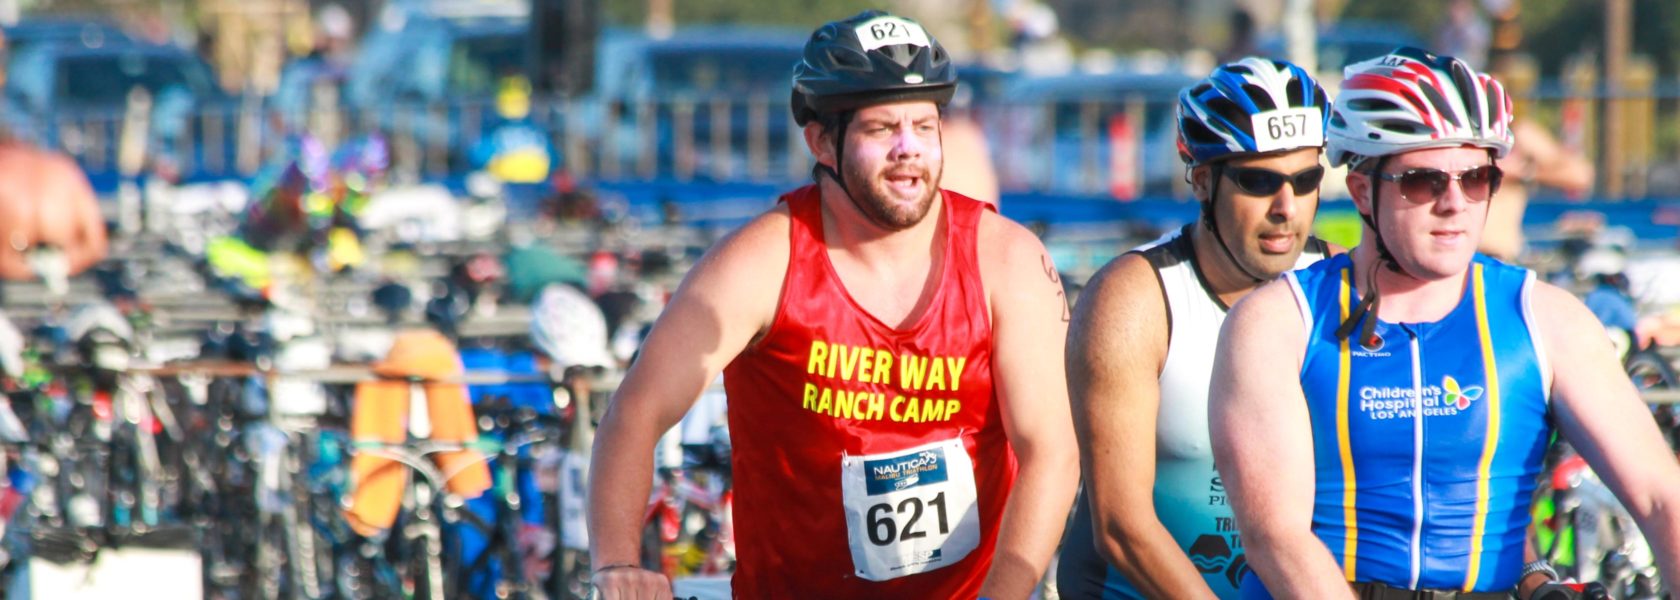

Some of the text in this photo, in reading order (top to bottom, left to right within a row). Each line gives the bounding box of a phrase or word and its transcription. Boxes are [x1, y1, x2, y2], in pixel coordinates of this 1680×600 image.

[870, 21, 911, 41] 621
[1267, 114, 1307, 140] 657
[807, 341, 967, 391] RIVER WAY
[1360, 385, 1441, 400] Children's
[802, 382, 962, 424] RANCH CAMP
[1361, 397, 1439, 414] Hospital
[1370, 410, 1395, 420] LOS
[873, 458, 927, 475] NAUTICA
[866, 491, 950, 546] 621
